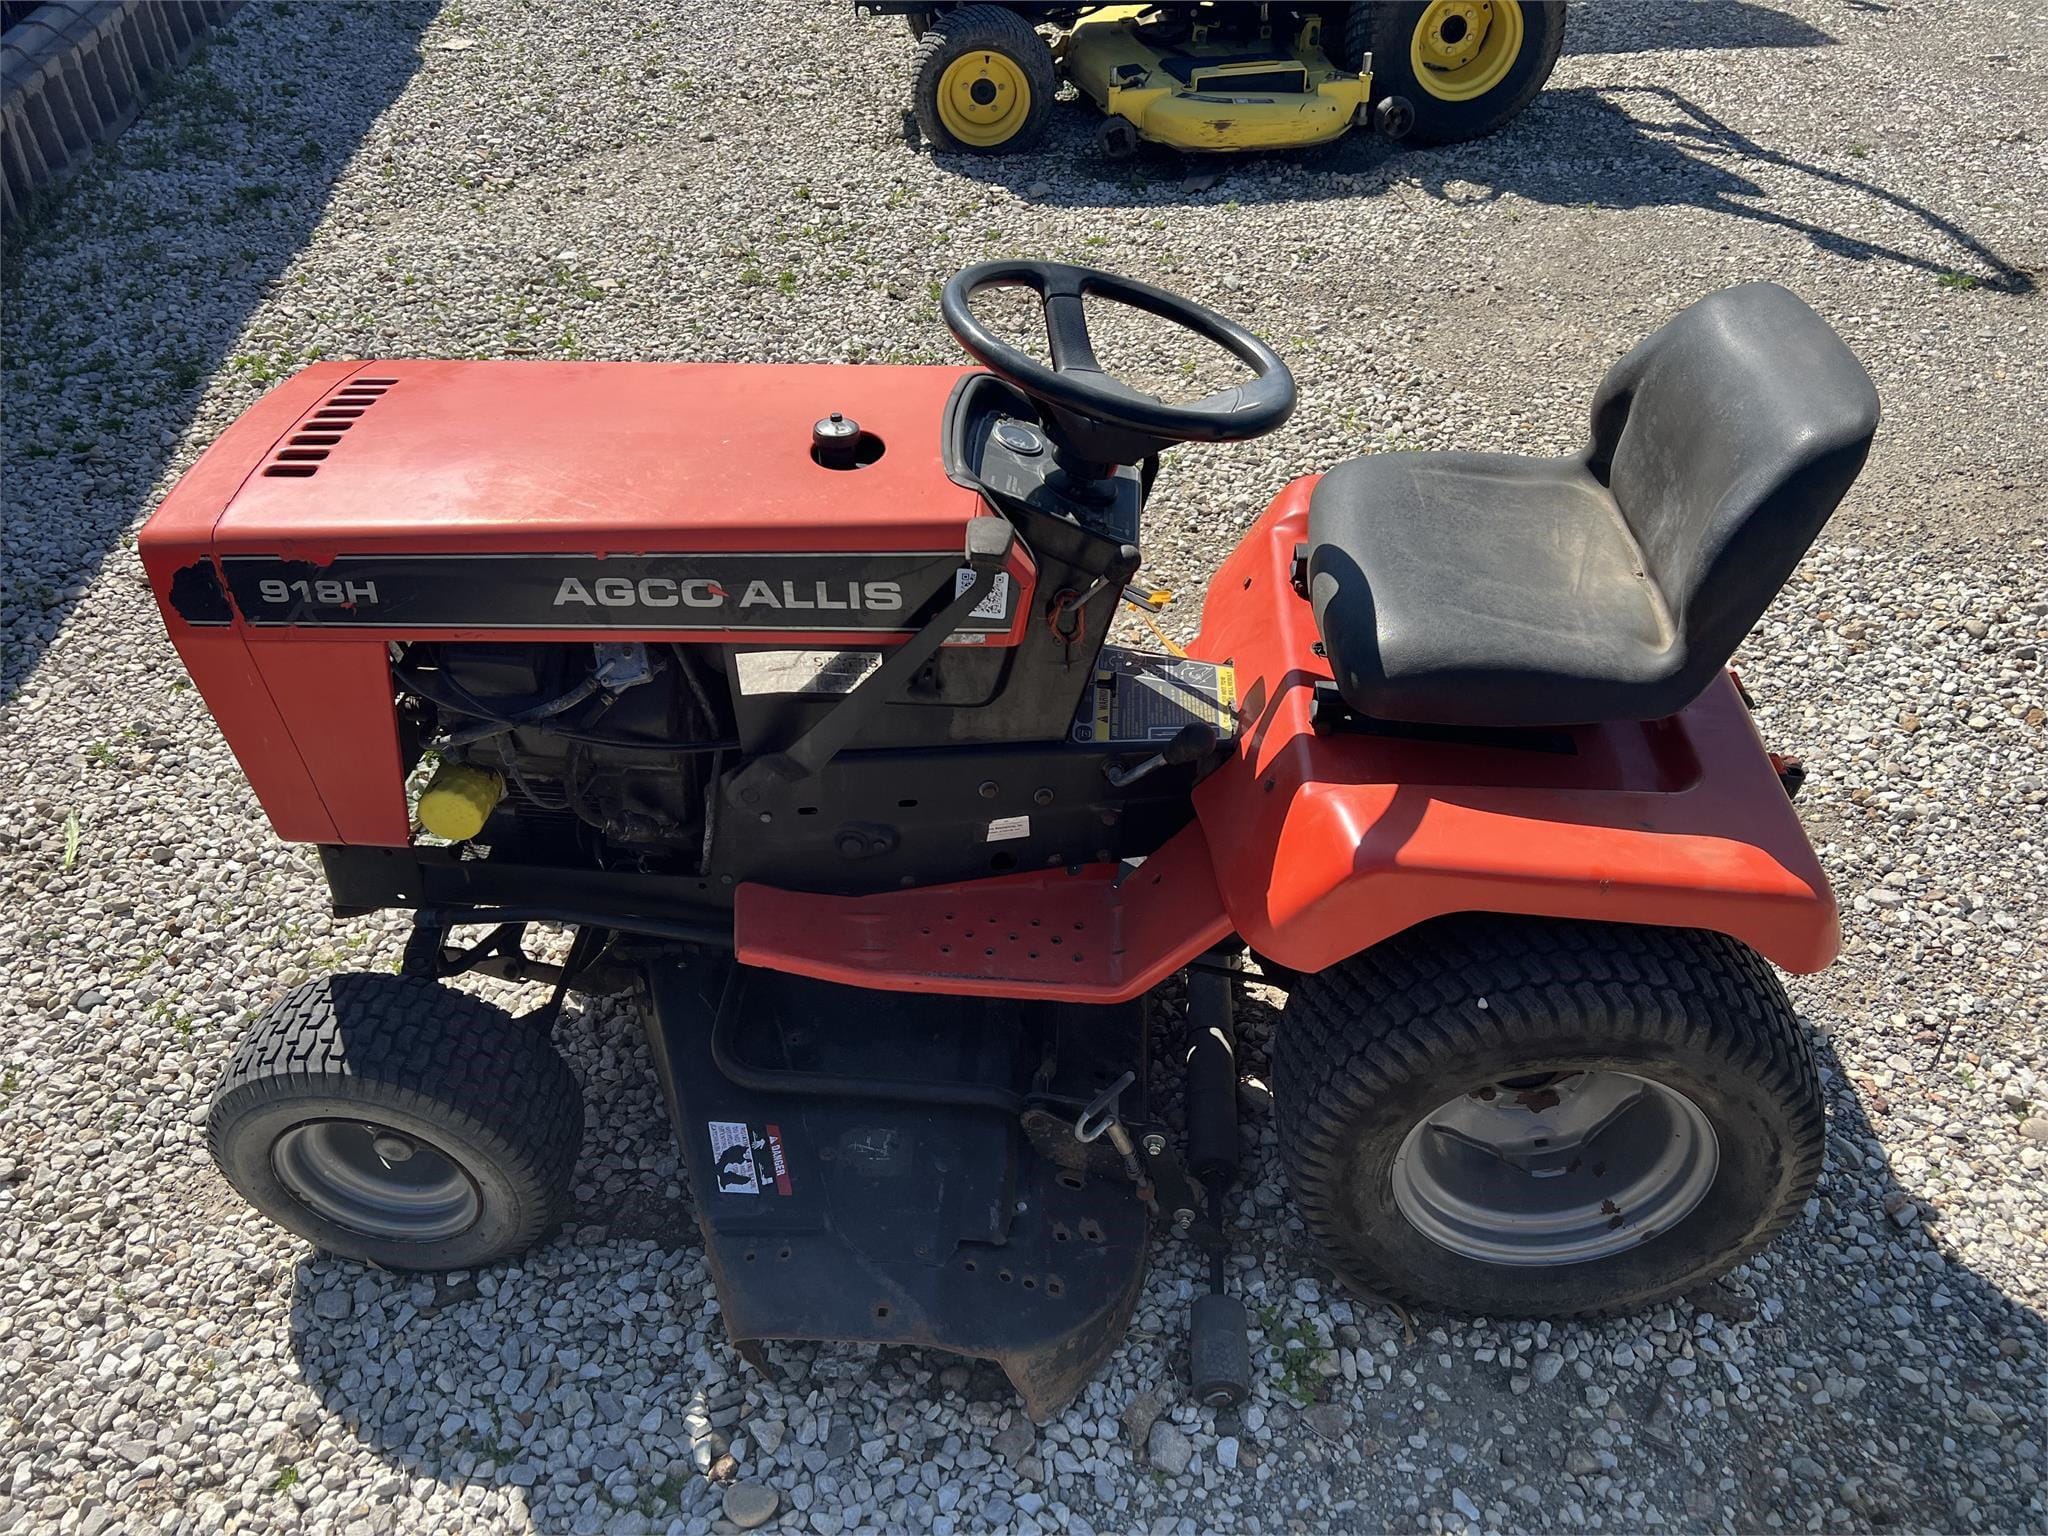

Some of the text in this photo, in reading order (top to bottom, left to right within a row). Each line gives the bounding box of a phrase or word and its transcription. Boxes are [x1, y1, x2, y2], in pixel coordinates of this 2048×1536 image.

[259, 580, 379, 603] 918H
[553, 577, 903, 610] AGCO ALLIS
[771, 1144, 786, 1177] DANGER
